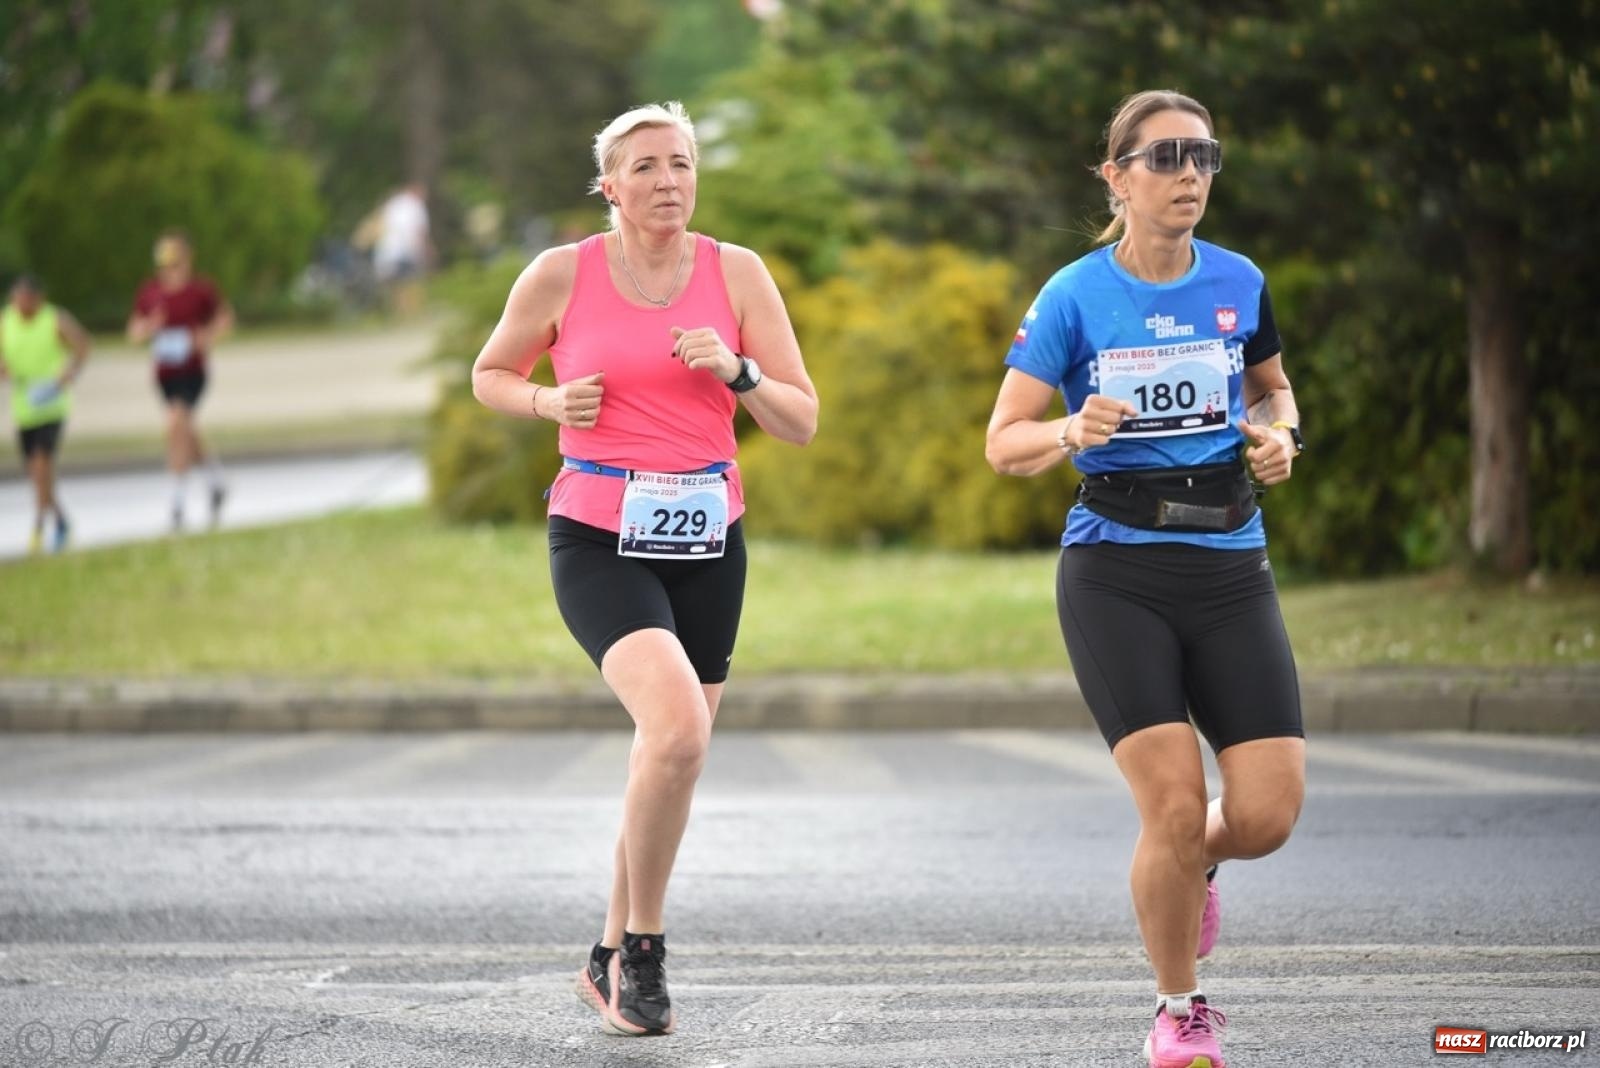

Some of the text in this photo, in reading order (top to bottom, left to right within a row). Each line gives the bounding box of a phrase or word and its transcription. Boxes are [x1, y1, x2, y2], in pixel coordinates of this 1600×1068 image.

[1108, 342, 1215, 361] XVII BIEG BEZ GRANIC
[1114, 364, 1136, 374] maja
[1136, 362, 1156, 370] 2025
[1134, 380, 1196, 413] 180
[635, 473, 655, 481] XVII
[656, 476, 679, 485] BIEG
[680, 477, 697, 486] BEZ
[640, 487, 659, 496] maja
[660, 488, 678, 496] 2025
[651, 508, 707, 537] 229
